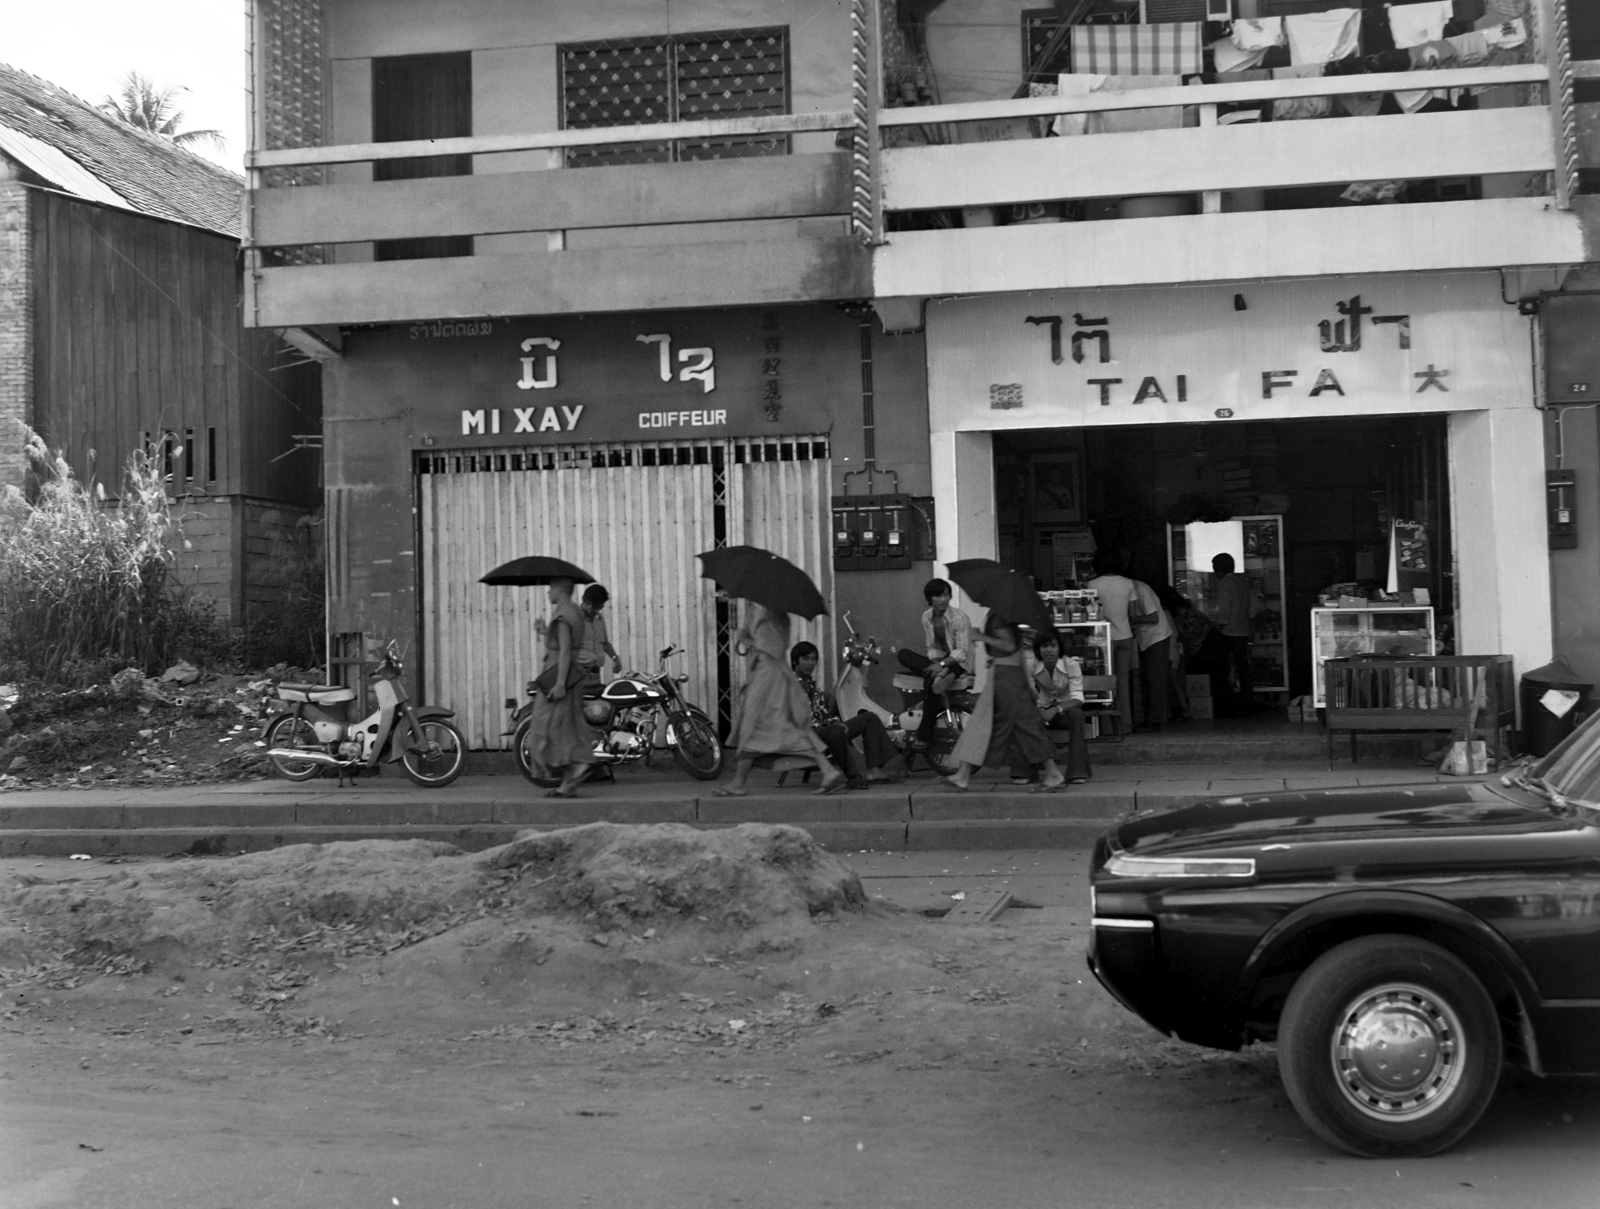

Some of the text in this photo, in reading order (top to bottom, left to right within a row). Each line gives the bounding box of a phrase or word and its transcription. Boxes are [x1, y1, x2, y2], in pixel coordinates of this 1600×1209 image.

[1088, 370, 1346, 406] TAI FA
[1572, 384, 1587, 392] 24
[639, 409, 728, 429] COIFFEUR
